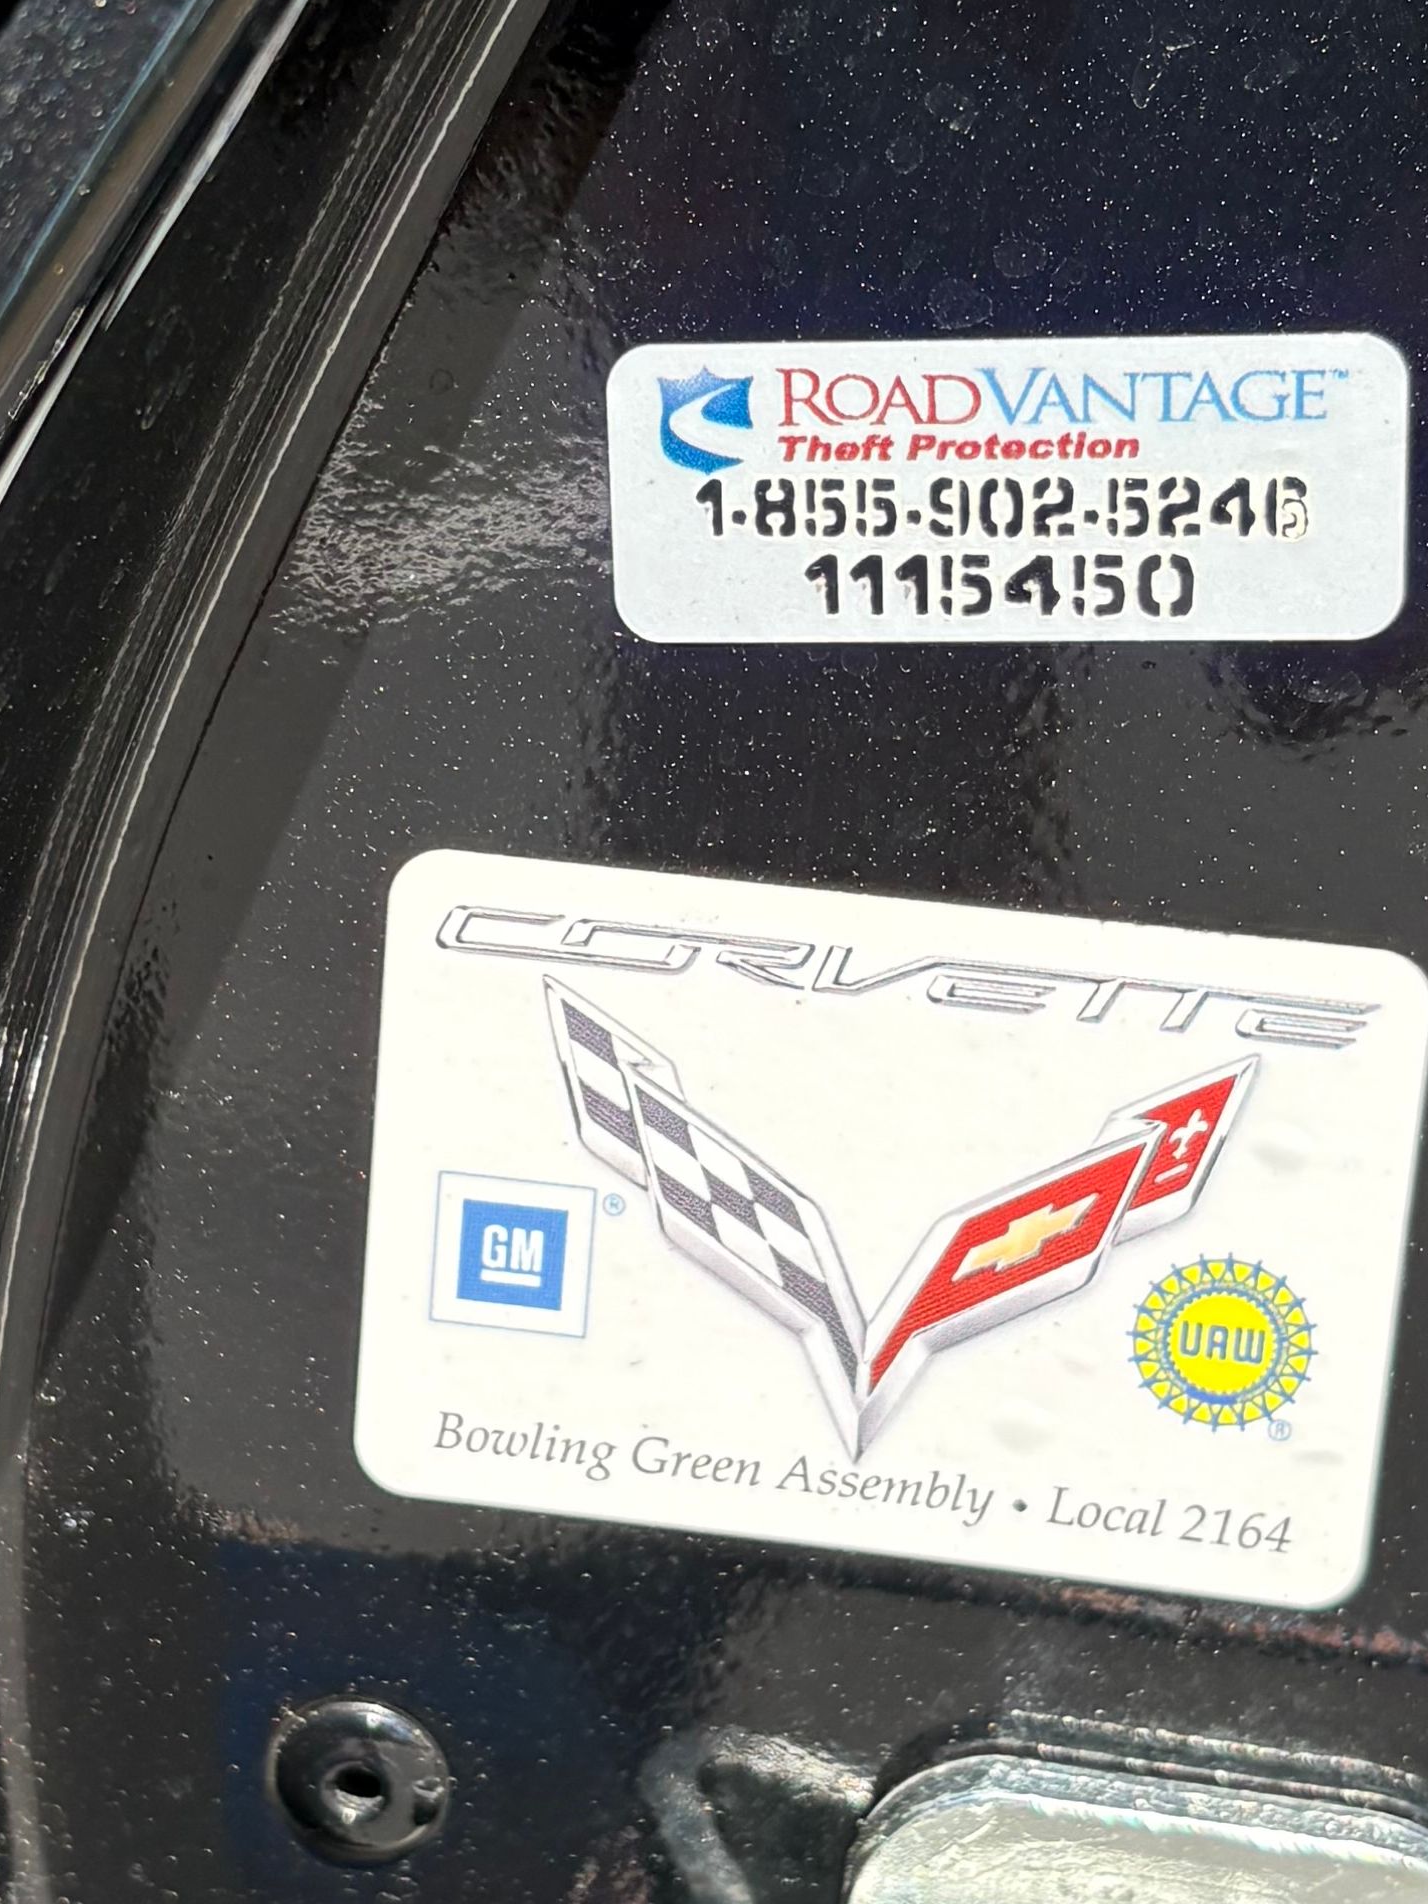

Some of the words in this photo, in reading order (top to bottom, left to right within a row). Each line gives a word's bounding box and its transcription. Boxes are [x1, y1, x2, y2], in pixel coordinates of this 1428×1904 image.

[778, 433, 895, 462] Theft
[907, 432, 1140, 461] Protection
[804, 554, 1196, 616] 1115450
[435, 905, 1382, 1050] CORVETTE
[481, 1224, 544, 1274] GM
[1180, 1320, 1265, 1364] UAW
[434, 1410, 618, 1482] Bowling
[632, 1436, 763, 1487] Green
[774, 1454, 995, 1527] Assembly
[1046, 1485, 1168, 1537] Local
[1178, 1504, 1293, 1554] 2164
